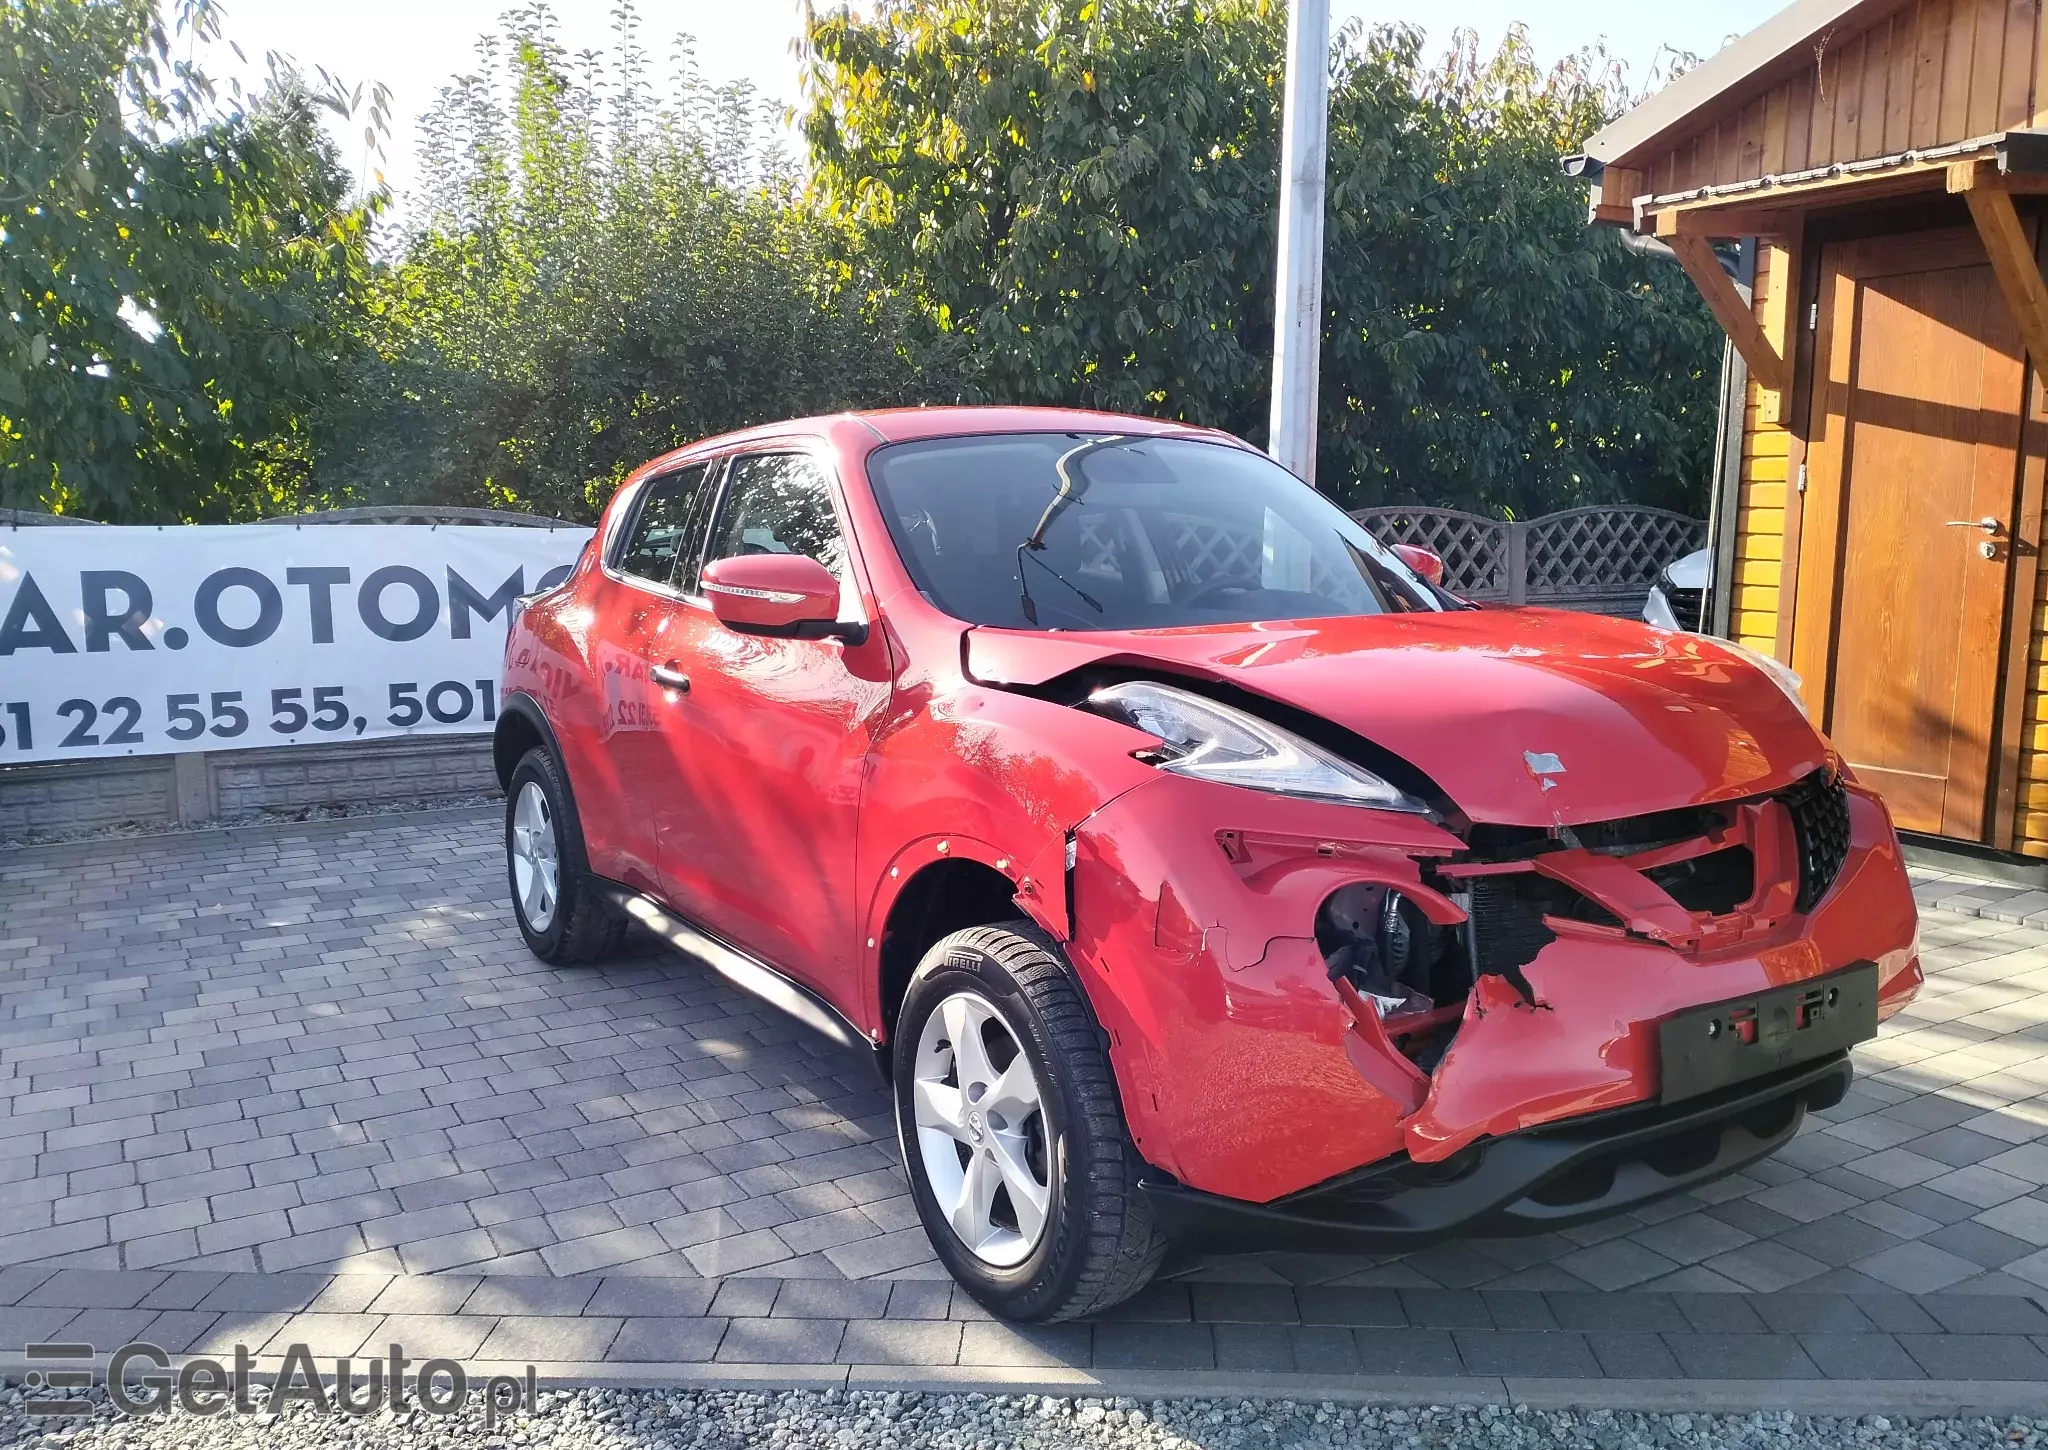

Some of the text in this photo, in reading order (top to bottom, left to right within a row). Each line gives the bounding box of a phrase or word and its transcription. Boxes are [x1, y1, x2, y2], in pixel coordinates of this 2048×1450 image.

[56, 697, 144, 749] 22
[165, 691, 249, 741] 55
[269, 685, 368, 736] 55,
[387, 679, 496, 727] 501
[943, 949, 984, 973] PIRELLI
